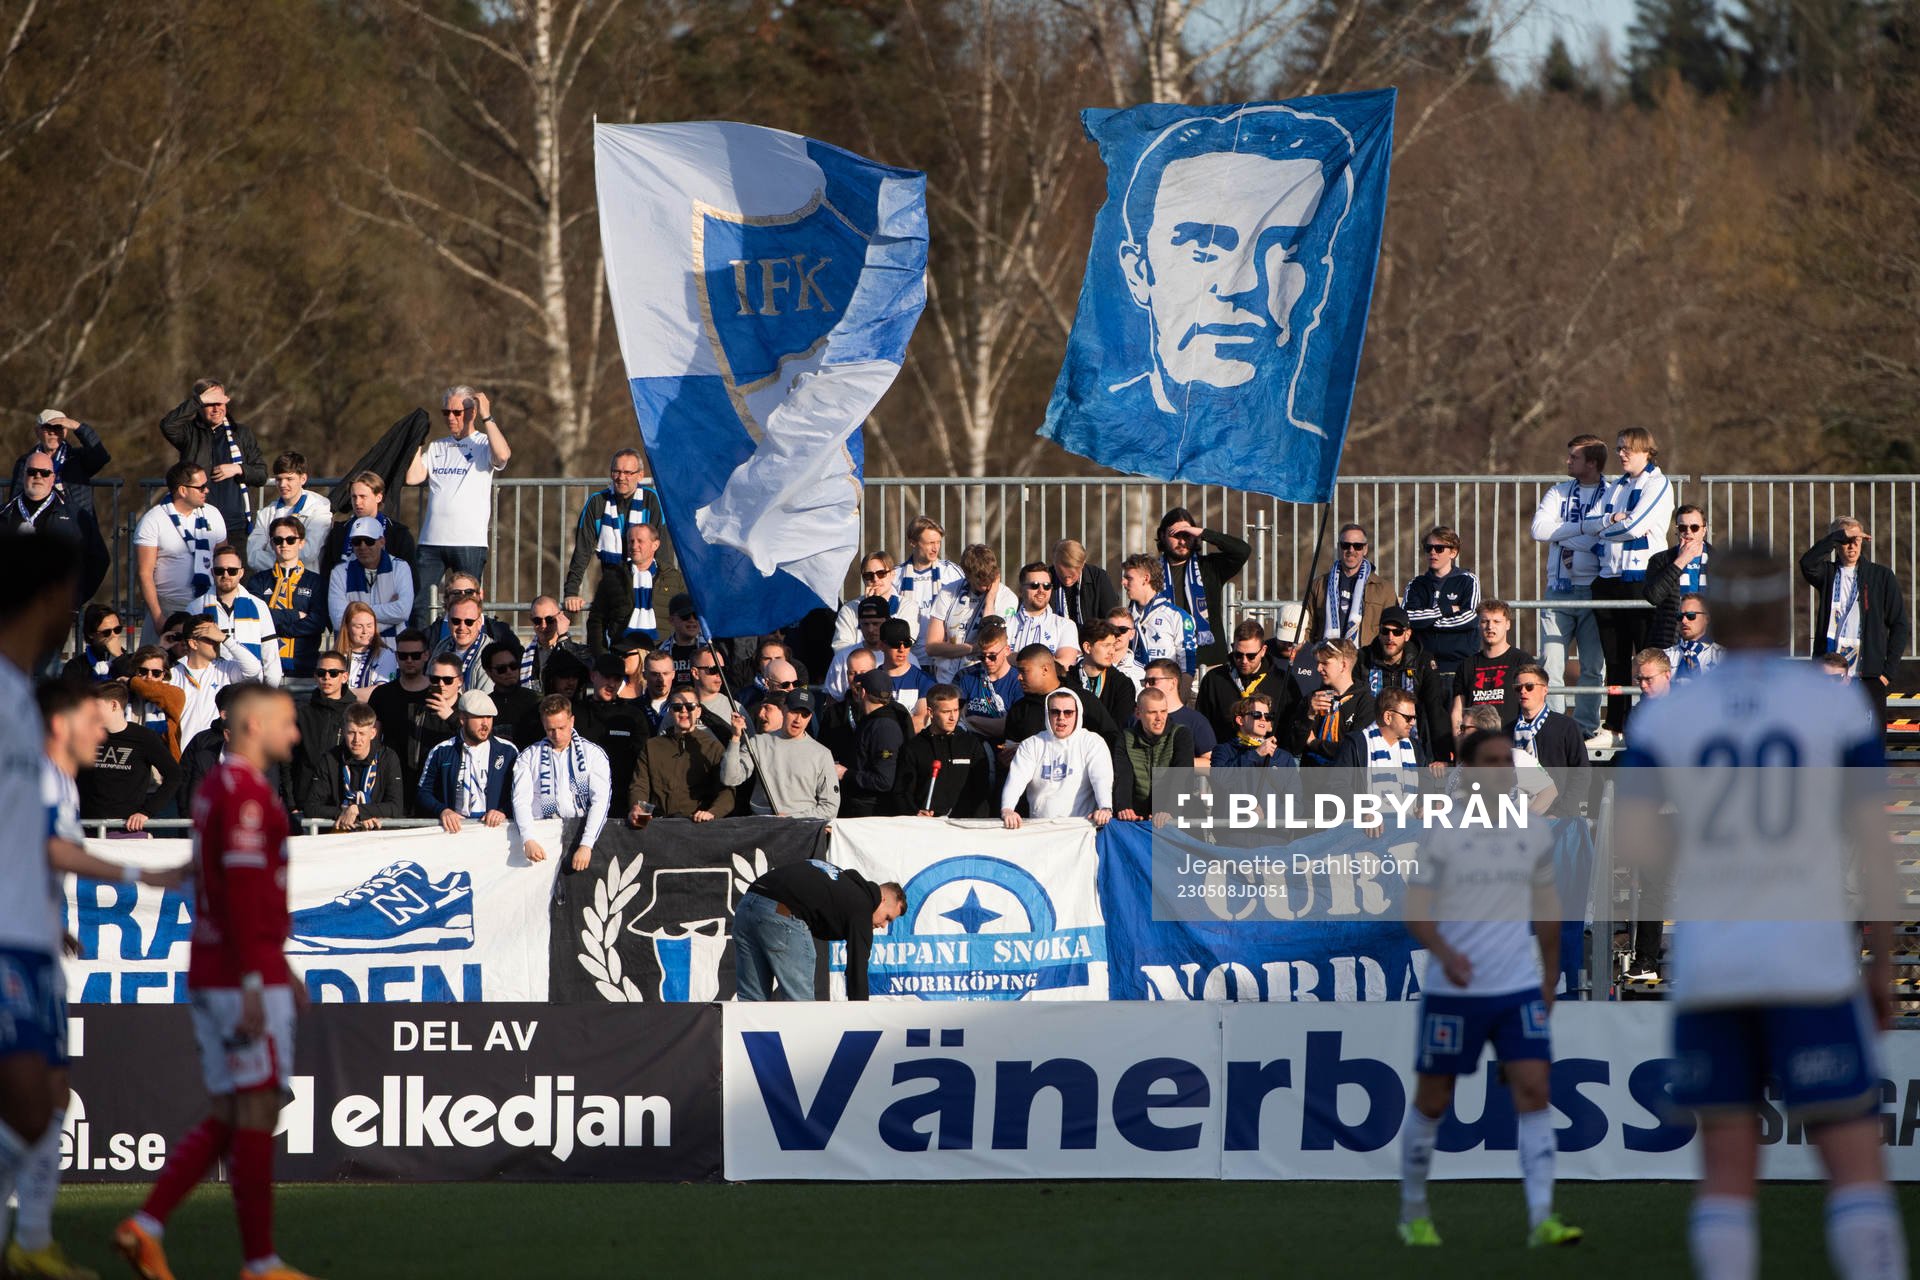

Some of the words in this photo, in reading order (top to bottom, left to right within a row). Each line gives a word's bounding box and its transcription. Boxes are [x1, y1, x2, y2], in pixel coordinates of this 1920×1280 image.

[729, 254, 835, 316] IFK
[432, 467, 468, 475] HOLMEN
[1298, 668, 1312, 676] Lee
[1473, 689, 1504, 697] UNDER
[832, 940, 969, 967] KMPANI
[994, 935, 1093, 964] SNOKA
[889, 971, 1038, 993] NORRKÖPING
[393, 1021, 473, 1052] DEL
[483, 1021, 539, 1052] AV
[331, 1075, 672, 1163] elkedjan
